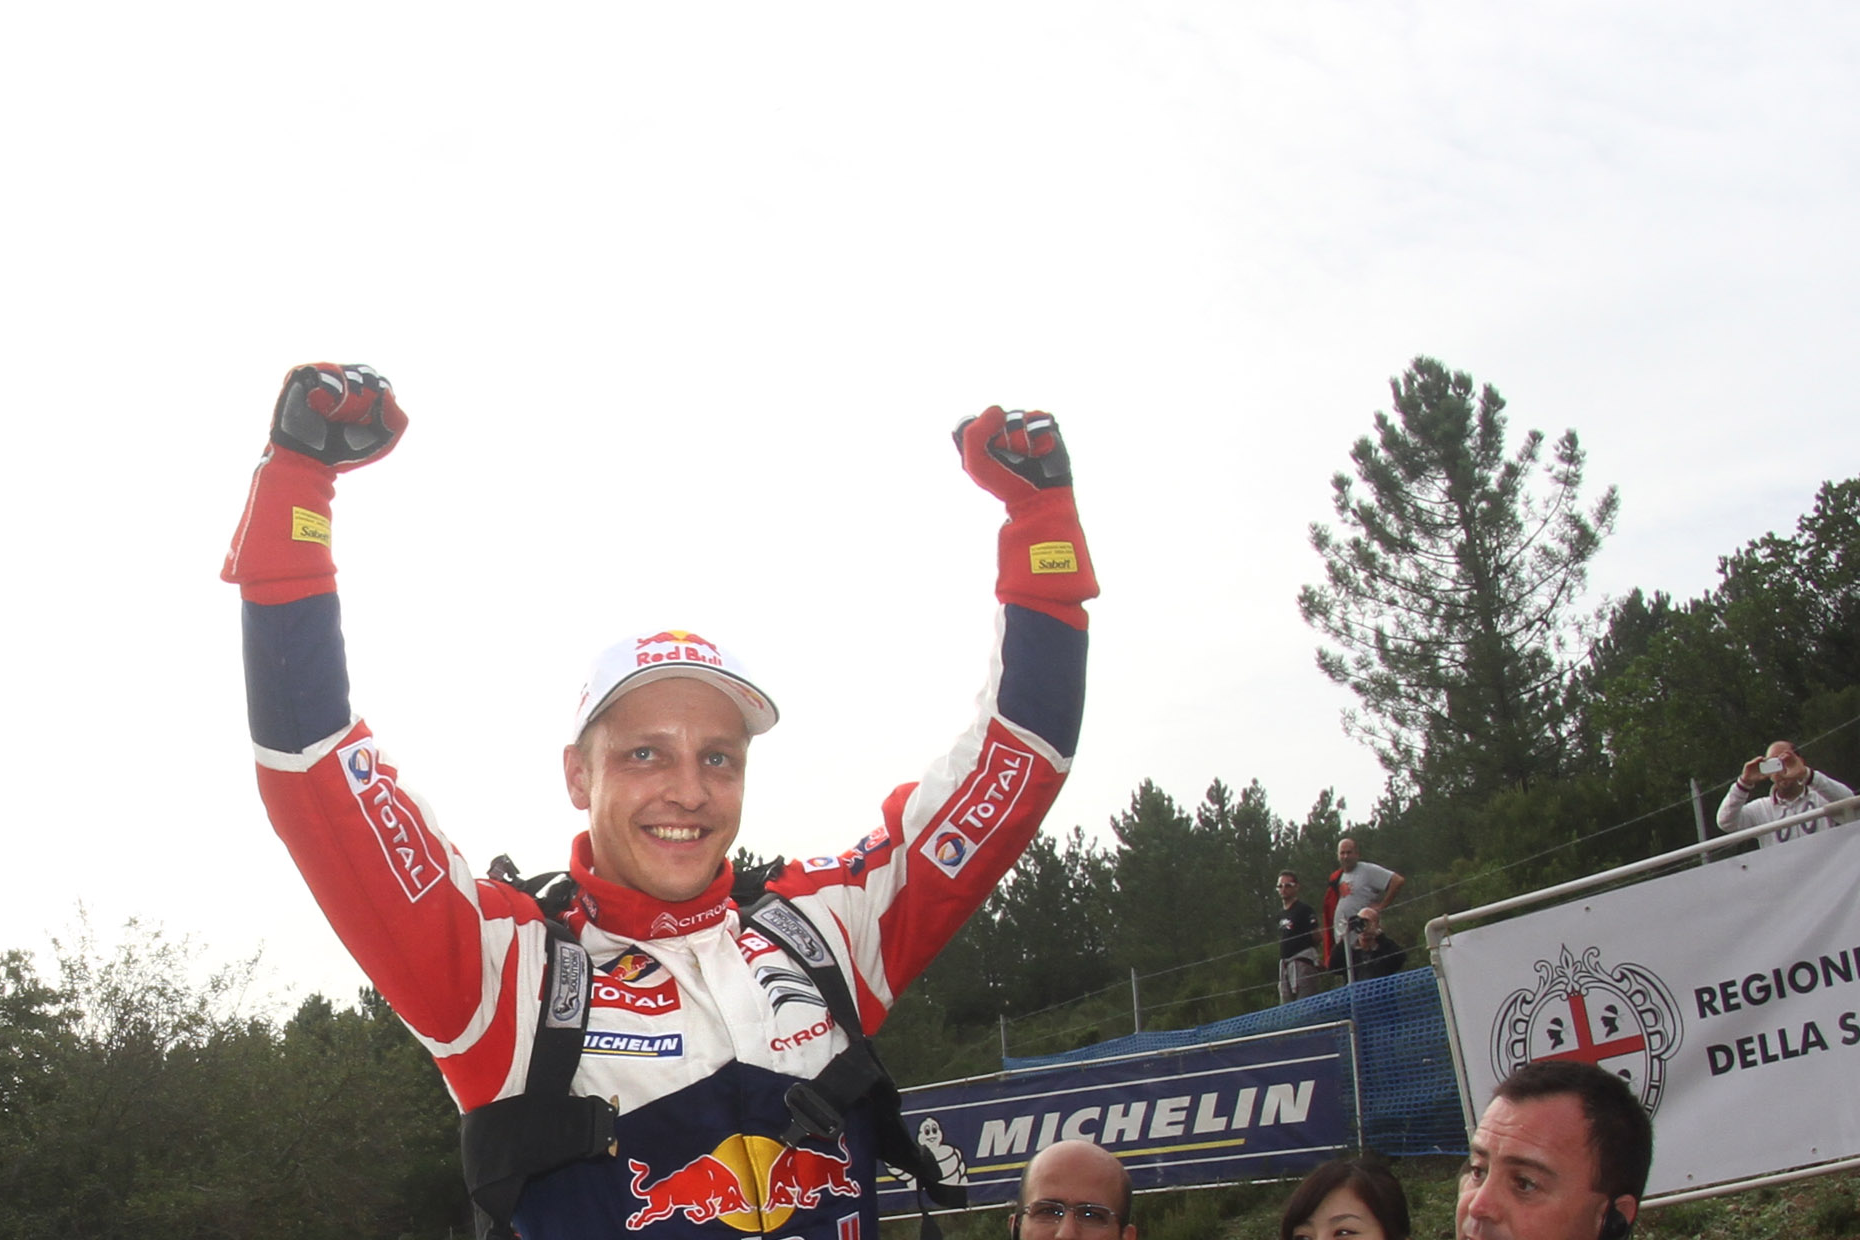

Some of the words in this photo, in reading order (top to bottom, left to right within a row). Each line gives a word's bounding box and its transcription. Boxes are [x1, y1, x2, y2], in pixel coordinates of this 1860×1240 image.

[636, 646, 680, 667] Red
[685, 647, 723, 667] Bull
[958, 757, 1021, 828] TOTAL
[374, 782, 424, 889] TOTAL
[1706, 1021, 1829, 1076] DELLA
[975, 1079, 1316, 1158] MICHELIN
